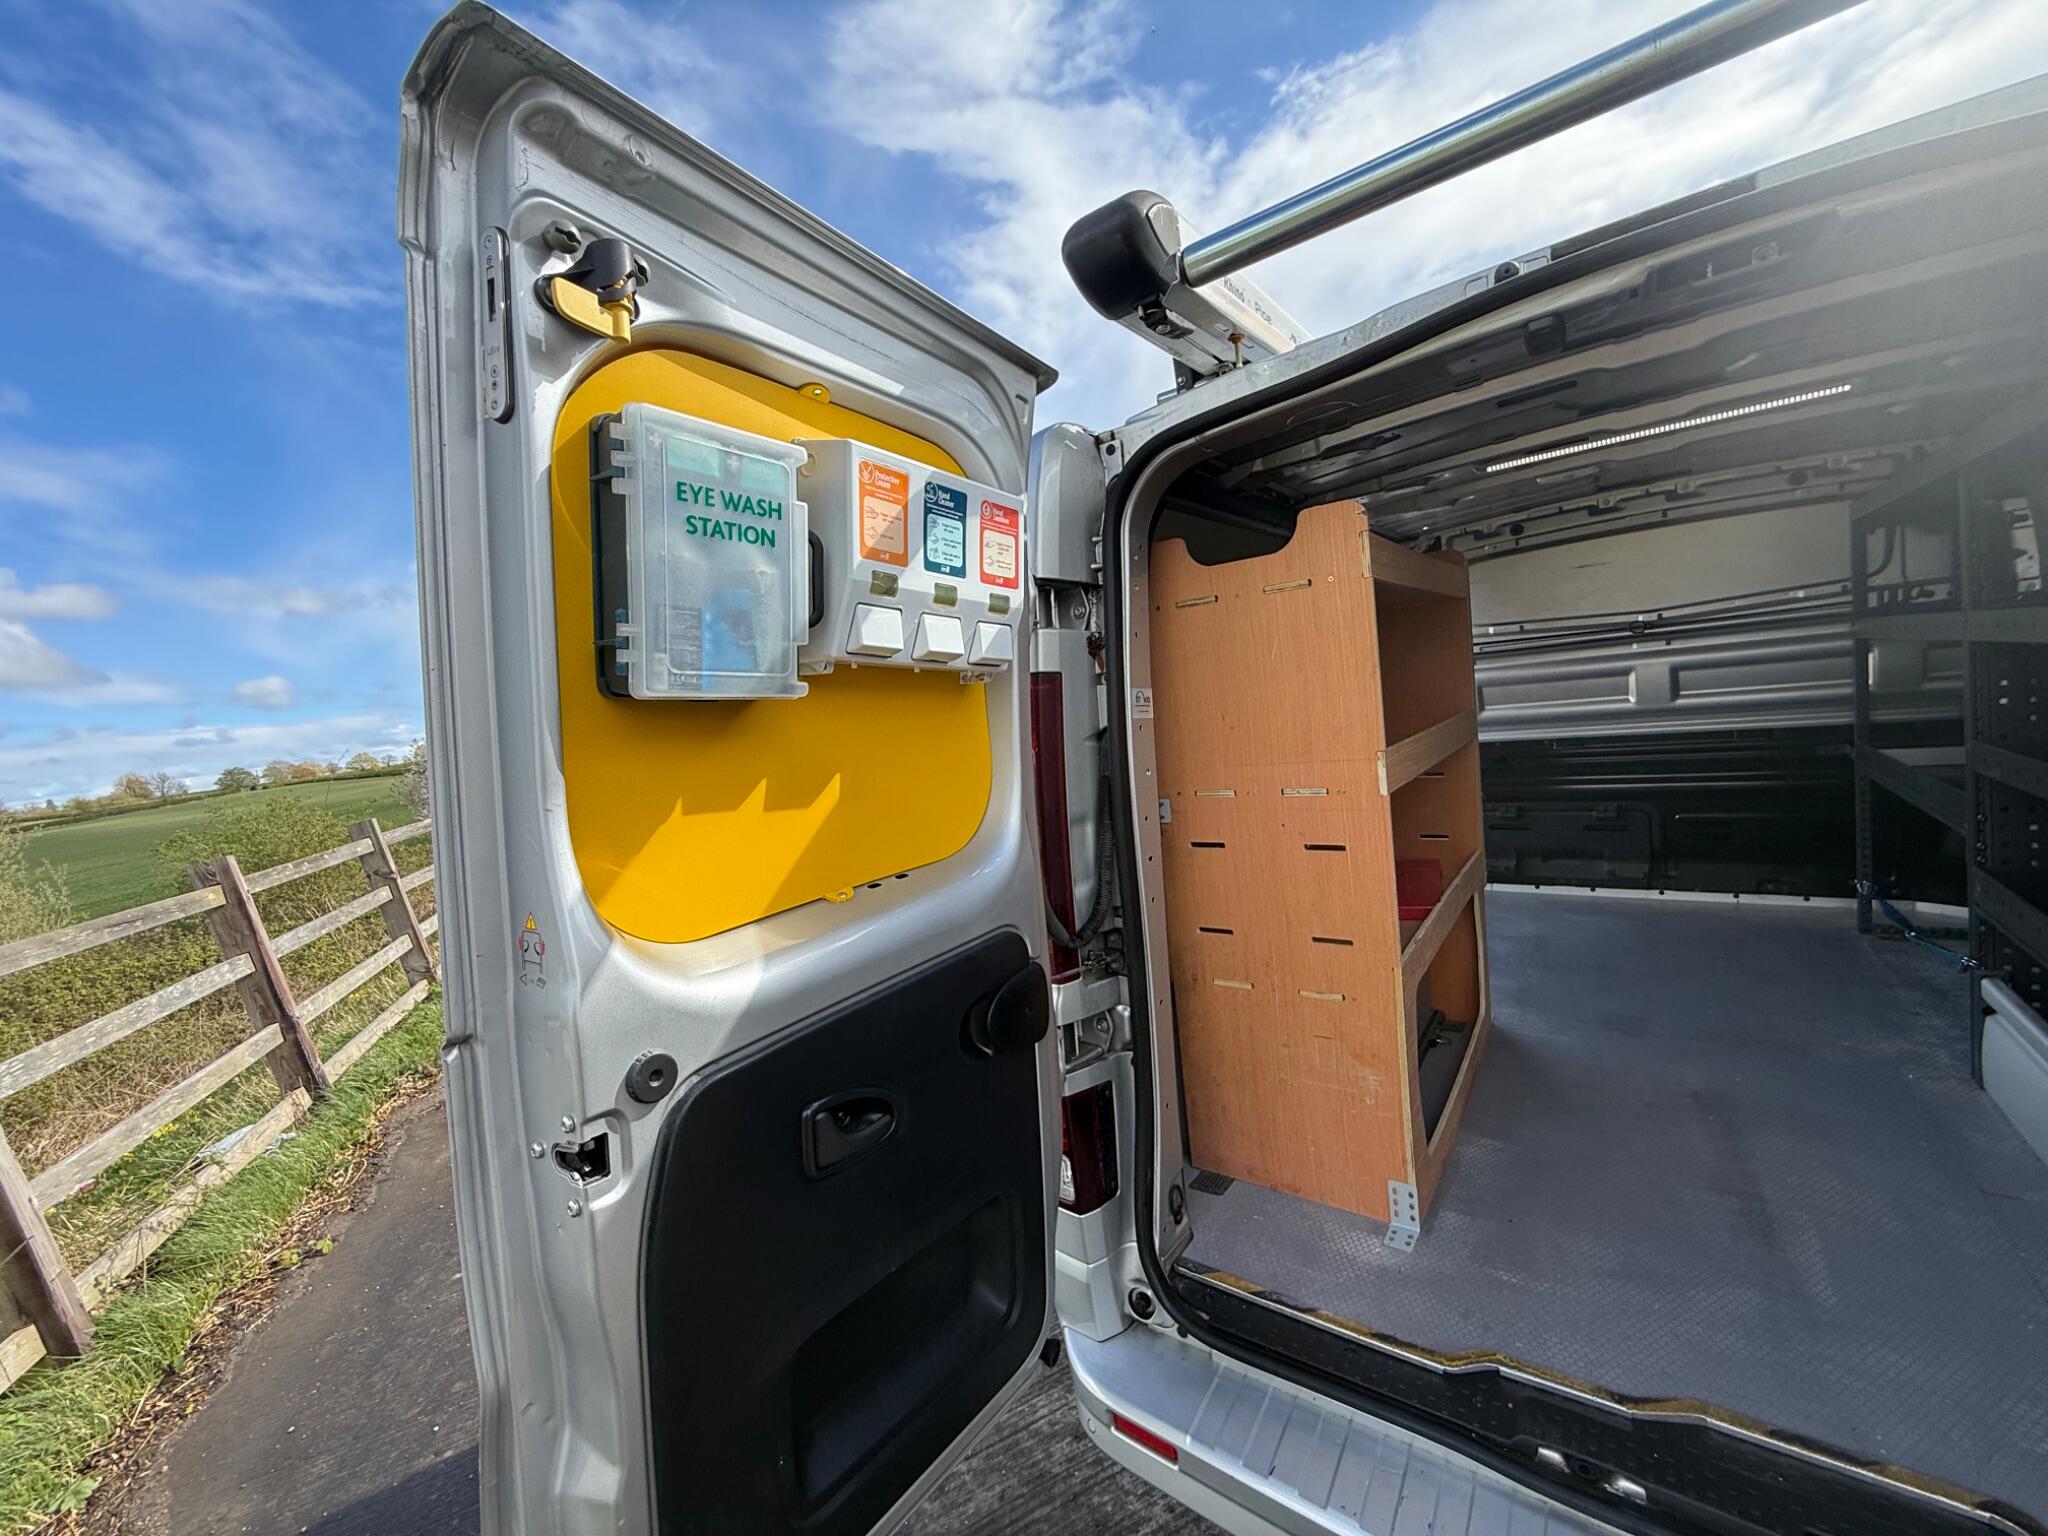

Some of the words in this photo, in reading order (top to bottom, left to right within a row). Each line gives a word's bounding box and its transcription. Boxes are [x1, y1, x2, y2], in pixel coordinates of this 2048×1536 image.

[676, 481, 716, 507] EYE
[720, 489, 782, 521] WASH
[686, 514, 776, 548] STATION
